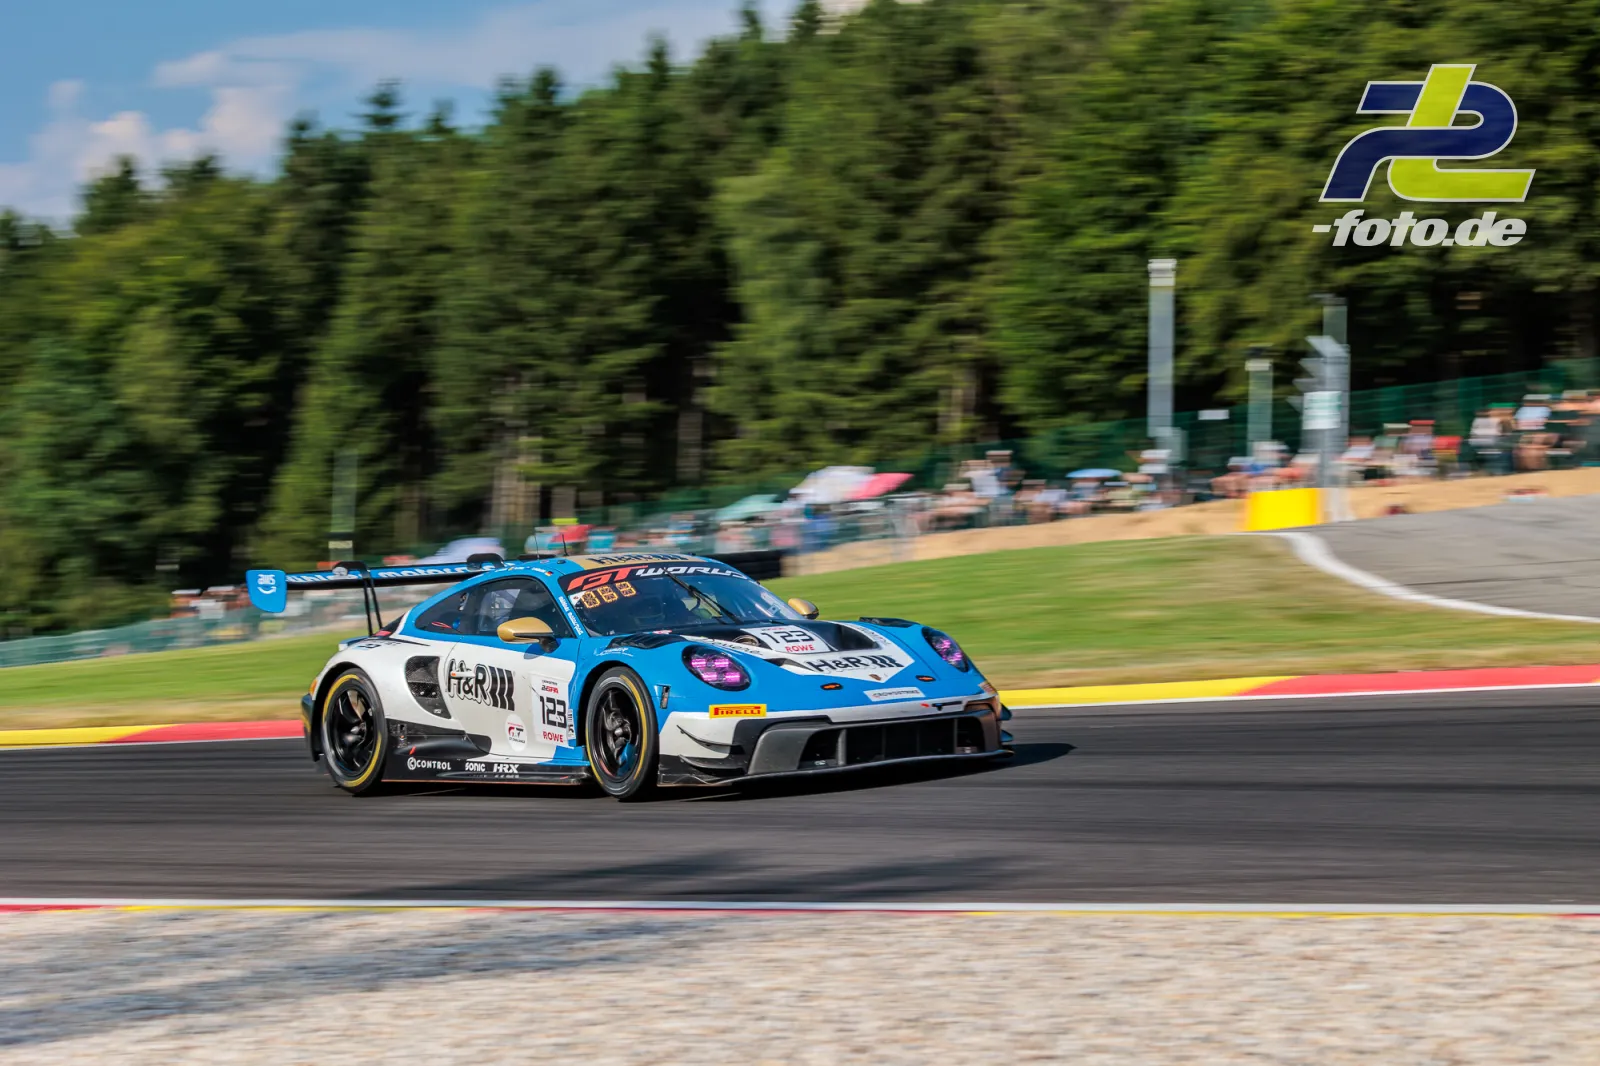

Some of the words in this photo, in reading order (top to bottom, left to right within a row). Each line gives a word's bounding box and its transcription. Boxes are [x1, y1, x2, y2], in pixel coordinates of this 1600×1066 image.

[257, 574, 276, 585] aws
[567, 564, 649, 591] GT
[760, 630, 815, 644] 123
[785, 644, 815, 653] ROWE
[805, 655, 870, 674] H&R
[446, 658, 491, 706] H&R
[540, 695, 567, 729] 123
[713, 705, 761, 716] PIRELLI
[542, 731, 564, 743] ROWE
[493, 763, 520, 774] HRX
